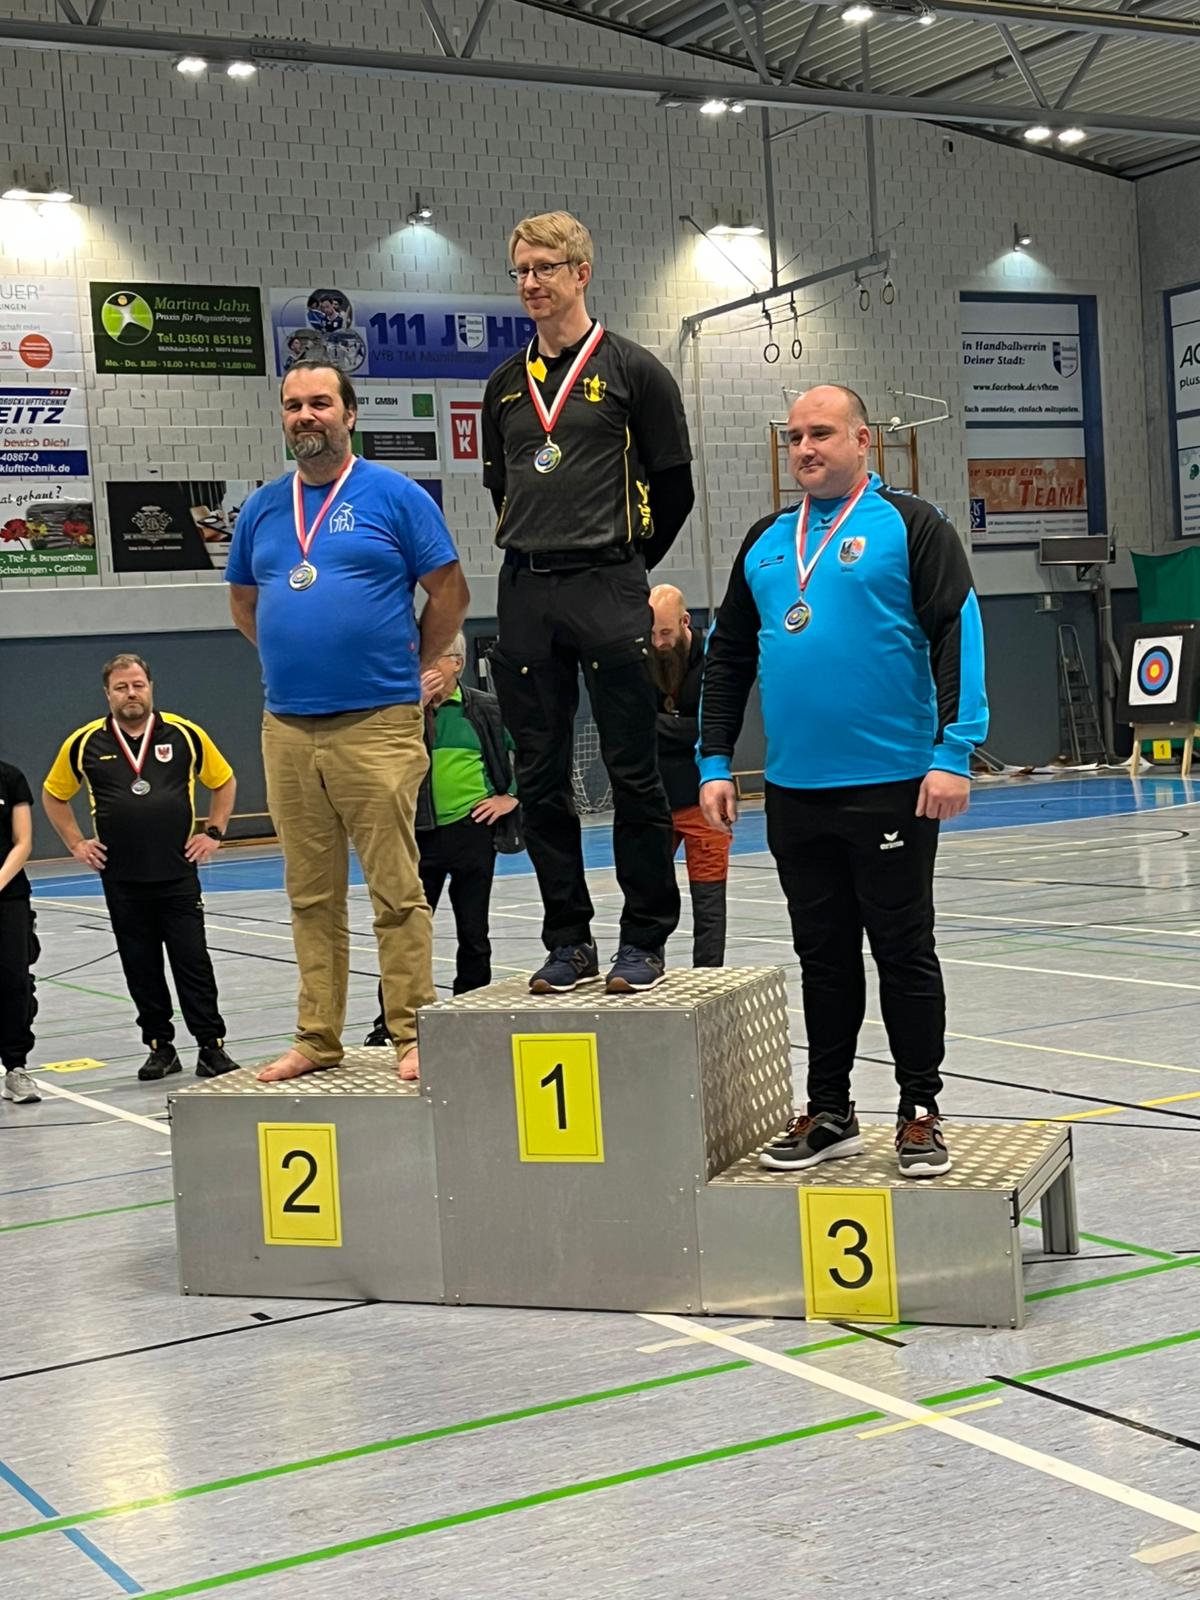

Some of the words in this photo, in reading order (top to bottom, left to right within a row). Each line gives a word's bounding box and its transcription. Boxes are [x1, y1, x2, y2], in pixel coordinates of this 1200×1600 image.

[155, 297, 209, 311] Martina
[213, 299, 250, 312] Jahn
[369, 313, 426, 346] 111
[157, 332, 176, 343] Tel.
[178, 334, 210, 345] 03601
[213, 334, 252, 346] 851819
[975, 341, 1047, 352] Handballverein
[964, 355, 995, 365] Deiner
[997, 356, 1026, 365] Stadt:
[0, 407, 65, 425] EITZ
[1018, 405, 1043, 413] einfach
[20, 427, 33, 435] KG
[455, 420, 473, 436] W
[460, 437, 472, 453] K
[985, 467, 1016, 477] sind
[1020, 467, 1043, 477] ein
[1019, 479, 1085, 507] TEAM!
[541, 1063, 567, 1130] 1
[281, 1149, 321, 1213] 2
[827, 1218, 873, 1289] 3
